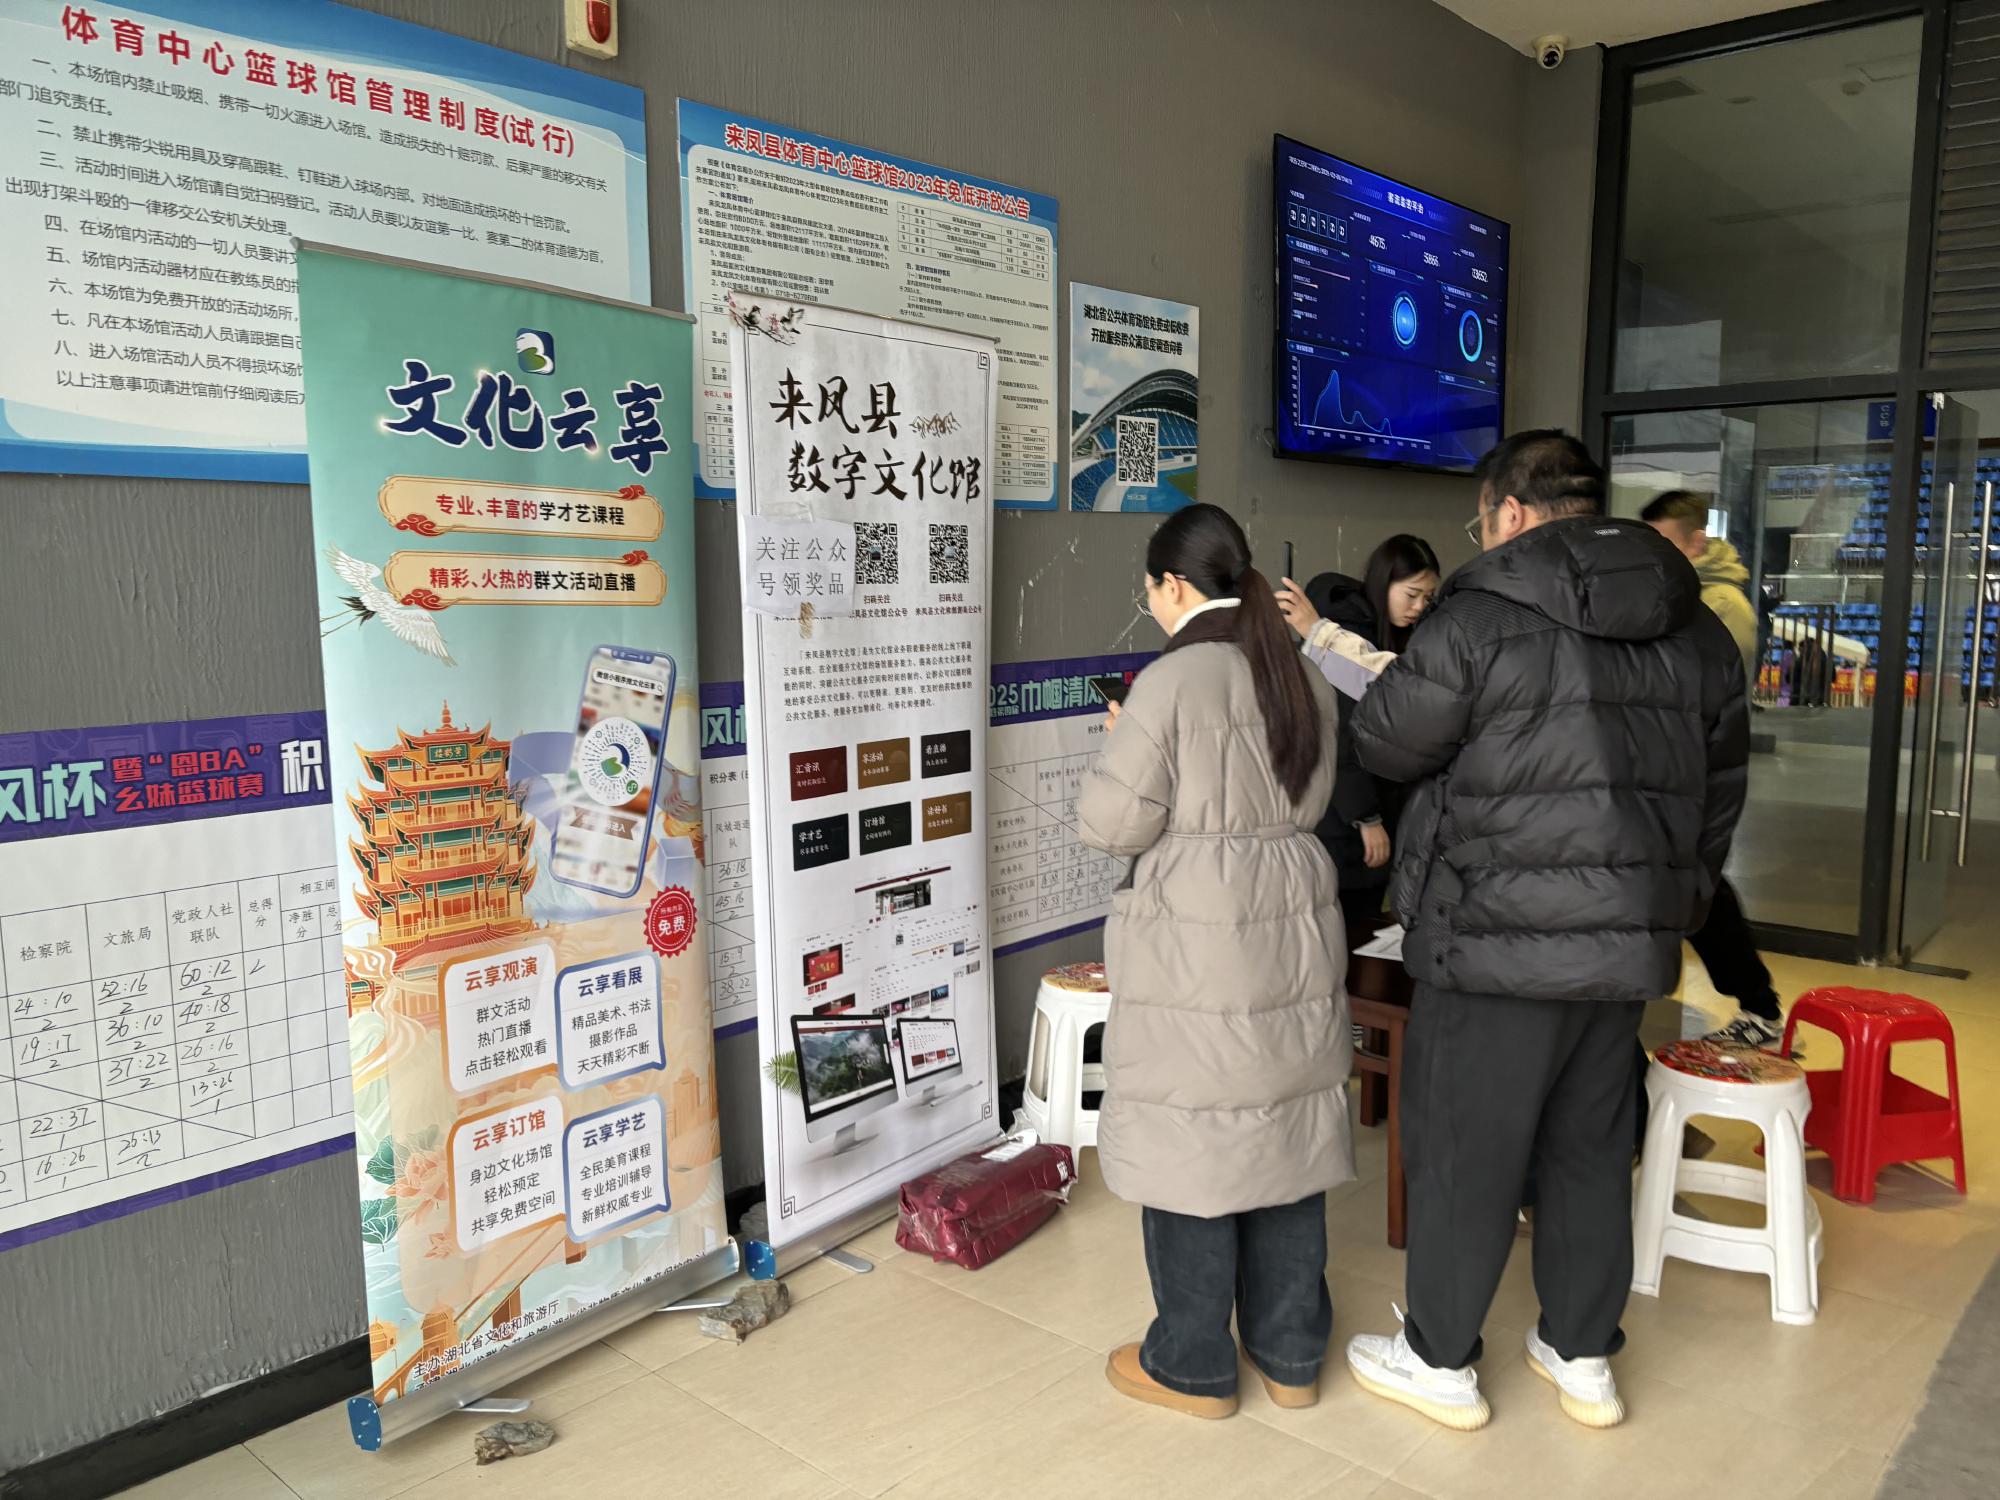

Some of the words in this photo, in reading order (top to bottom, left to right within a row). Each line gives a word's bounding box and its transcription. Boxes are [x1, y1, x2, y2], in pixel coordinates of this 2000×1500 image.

[62, 5, 574, 158] 体育中心篮球馆管理制度(试行)
[725, 123, 1031, 220] 来凤县体育中心篮球馆2023年免低开放公告
[383, 359, 670, 475] 文化云享
[769, 367, 901, 439] 来凤县
[787, 440, 981, 504] 数字文化馆
[436, 493, 625, 526] 专业、丰富的学才艺课程
[756, 537, 847, 562] 关注公众
[429, 567, 636, 592] 精彩、火热的群文活动直播
[757, 572, 844, 596] 号领奖品
[702, 704, 746, 748] 风
[281, 739, 325, 795] 积
[0, 760, 107, 823] 风杯
[171, 902, 234, 925] 党政人社
[659, 915, 686, 937] 免费
[20, 941, 72, 962] 检察院
[104, 927, 152, 947] 文旅局
[190, 926, 220, 944] 联队
[464, 957, 538, 993] 云享观演
[578, 966, 643, 998] 云享看展
[476, 996, 531, 1024] 群文活动
[571, 998, 652, 1031] 精品美术、书法
[478, 1019, 532, 1049] 热门直播
[589, 1023, 639, 1049] 摄影作品
[465, 1039, 548, 1077] 点击轻松观看
[577, 1041, 650, 1075] 天天精彩不断
[472, 1110, 547, 1151] 云享订馆
[582, 1112, 647, 1149] 云享学艺
[470, 1143, 553, 1187] 身边文化场馆
[579, 1143, 652, 1181] 全民美育课程
[483, 1172, 541, 1205] 轻松预定
[581, 1165, 653, 1202] 专业培训辅导
[472, 1190, 556, 1236] 共享免费空间
[582, 1185, 653, 1225] 新鲜权威专业
